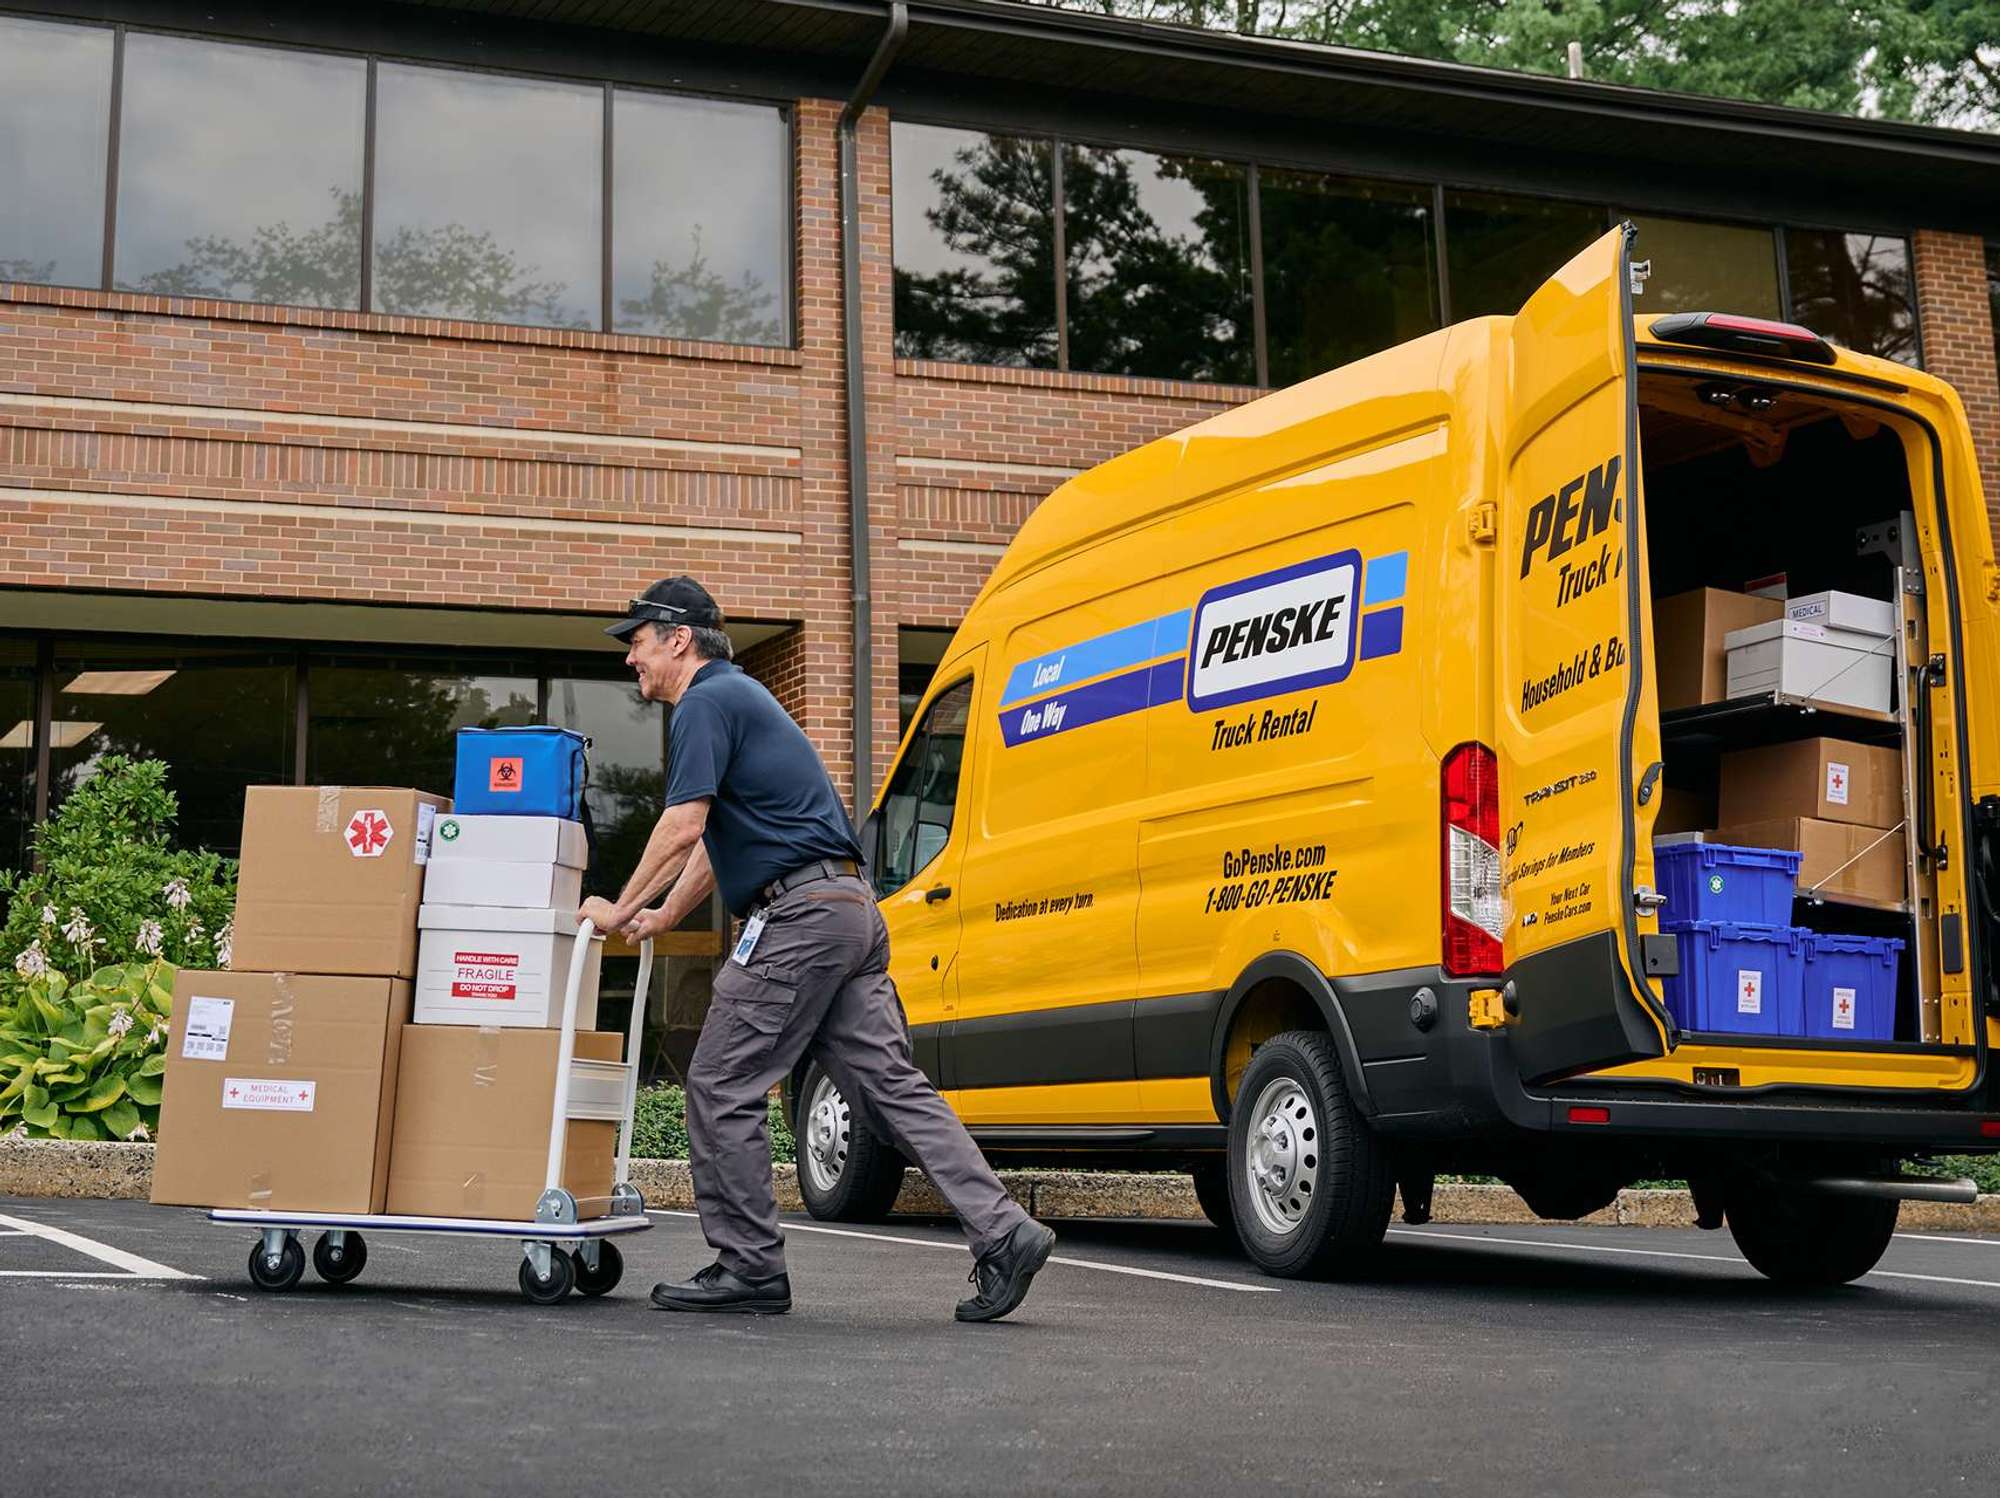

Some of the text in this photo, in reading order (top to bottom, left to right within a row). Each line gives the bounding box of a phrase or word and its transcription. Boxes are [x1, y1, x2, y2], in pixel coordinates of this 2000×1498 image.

[1520, 455, 1622, 580] PEN
[1557, 543, 1611, 608] Truck
[1792, 605, 1823, 618] MEDICAL
[1200, 594, 1346, 669] PENSKE
[1032, 655, 1066, 689] Local
[1521, 650, 1587, 714] Household
[1589, 643, 1601, 679] &
[1020, 700, 1067, 736] One Way
[1211, 699, 1319, 751] Truck Rental
[1223, 843, 1326, 879] GoPenske.com
[1519, 858, 1547, 877] Savings
[1545, 852, 1560, 872] for
[1558, 841, 1595, 866] Members
[995, 899, 1038, 922] Dedication
[1038, 898, 1048, 915] at
[1049, 896, 1074, 915] every
[1205, 870, 1338, 914] 1-800-GO-PENSKE
[1550, 882, 1591, 906] Your Next Car
[456, 953, 517, 965] HANDLE WITH CARE
[457, 967, 515, 981] FRAGILE
[459, 983, 510, 993] DO NOT DROP
[243, 1094, 294, 1104] EQUIPMENT
[251, 1084, 289, 1094] MEDICAL
